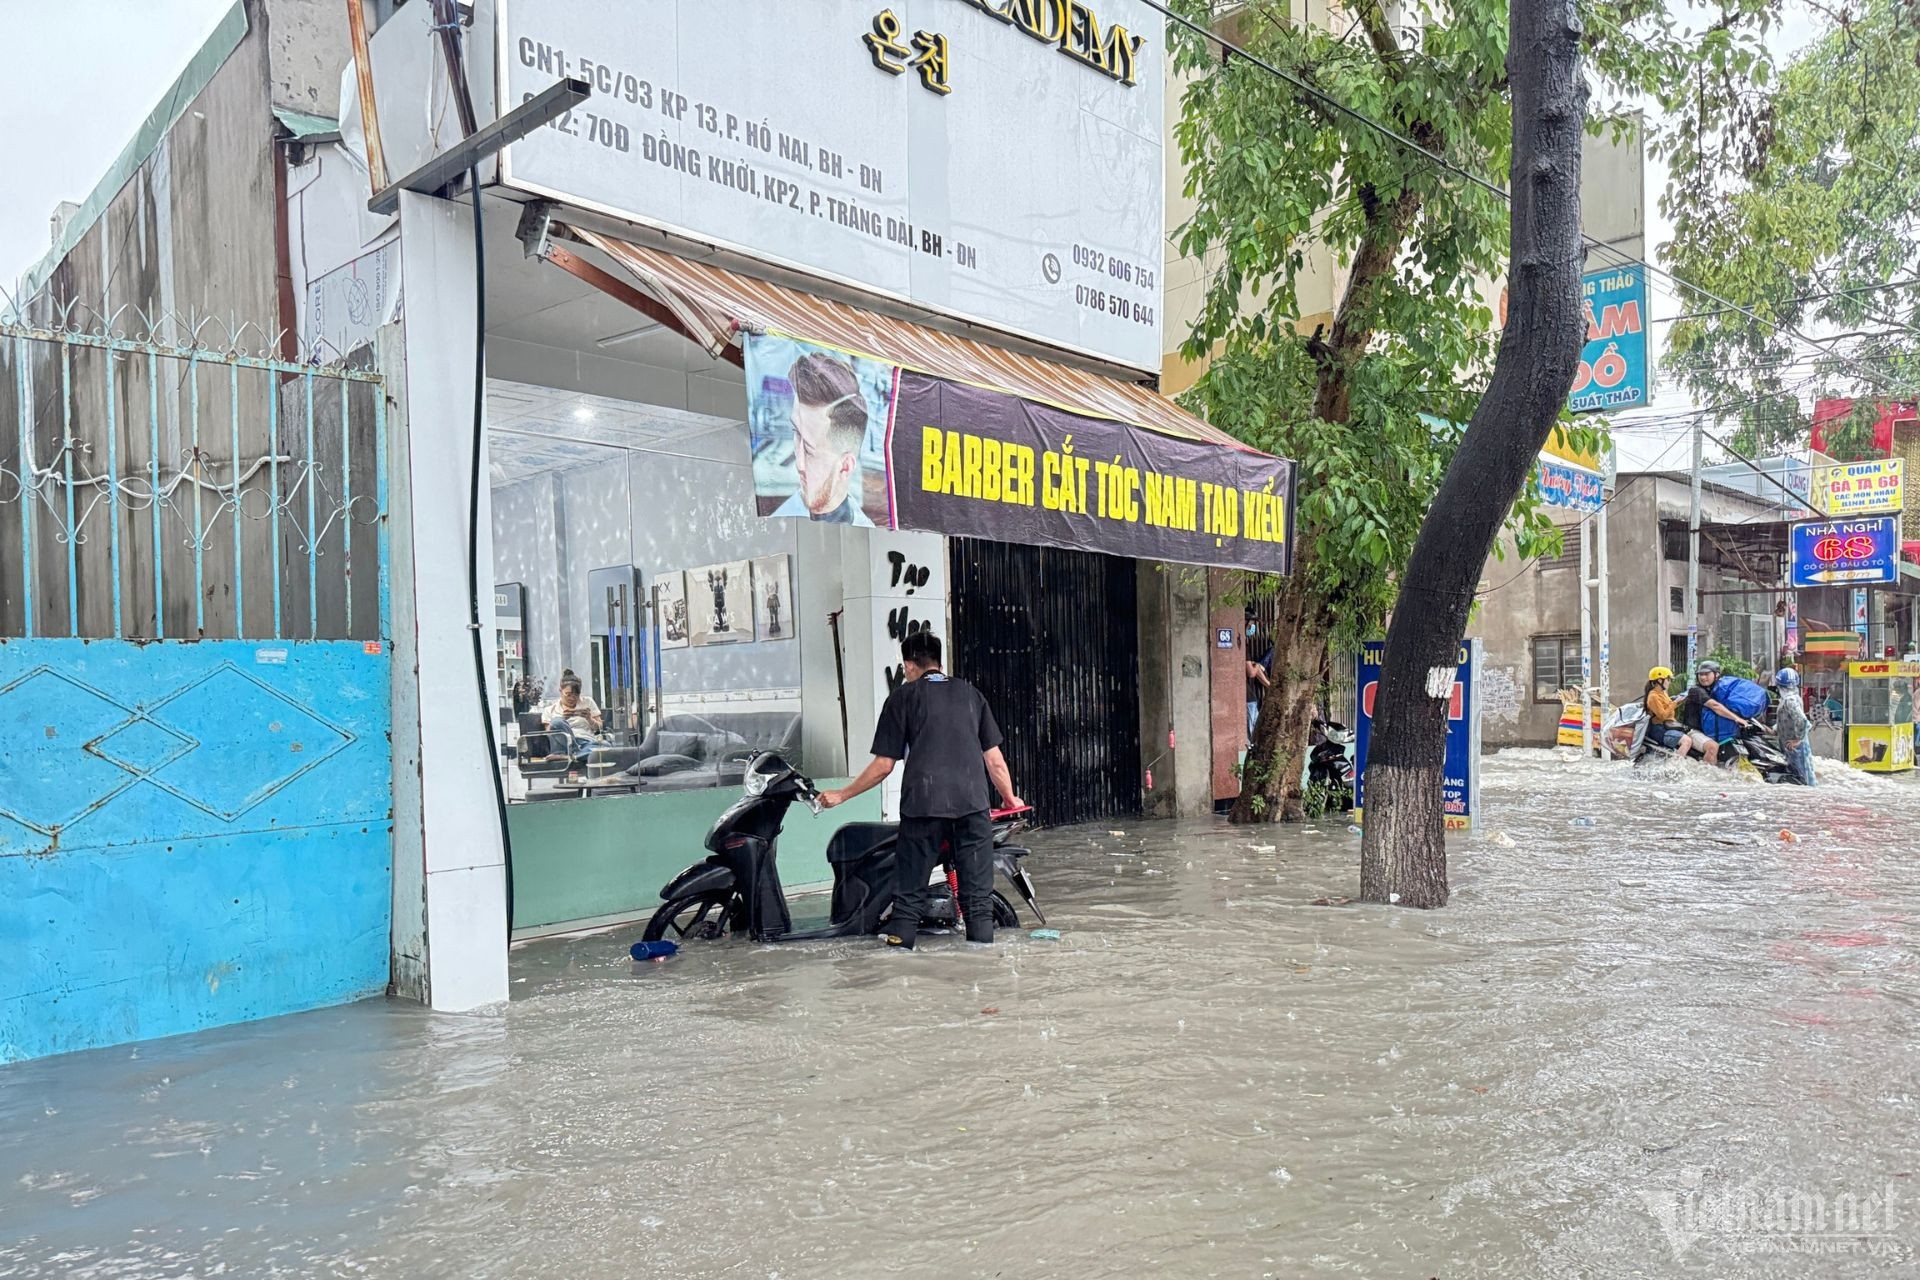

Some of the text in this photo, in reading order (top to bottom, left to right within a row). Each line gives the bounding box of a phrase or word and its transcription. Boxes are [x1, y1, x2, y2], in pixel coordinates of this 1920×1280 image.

[518, 36, 571, 78] CN1:
[579, 57, 653, 109] 5C/93
[661, 88, 688, 121] KP
[746, 117, 772, 153] HỐ
[778, 132, 813, 171] NAI,
[819, 148, 843, 180] BH
[859, 163, 883, 194] ĐN
[642, 128, 701, 178] ĐỒNG
[827, 197, 882, 238] TRẢNG
[922, 229, 942, 258] BH
[956, 241, 977, 270] ĐN
[1073, 243, 1154, 291] 0932 606 754
[1076, 284, 1154, 327] 0786 570 644
[921, 425, 1284, 548] BARBER CẮT TÓC NAM TẠO KIỂU
[1856, 478, 1873, 490] TA
[1878, 474, 1899, 488] 68
[1806, 523, 1838, 537] NHÀ
[1813, 536, 1875, 561] 68
